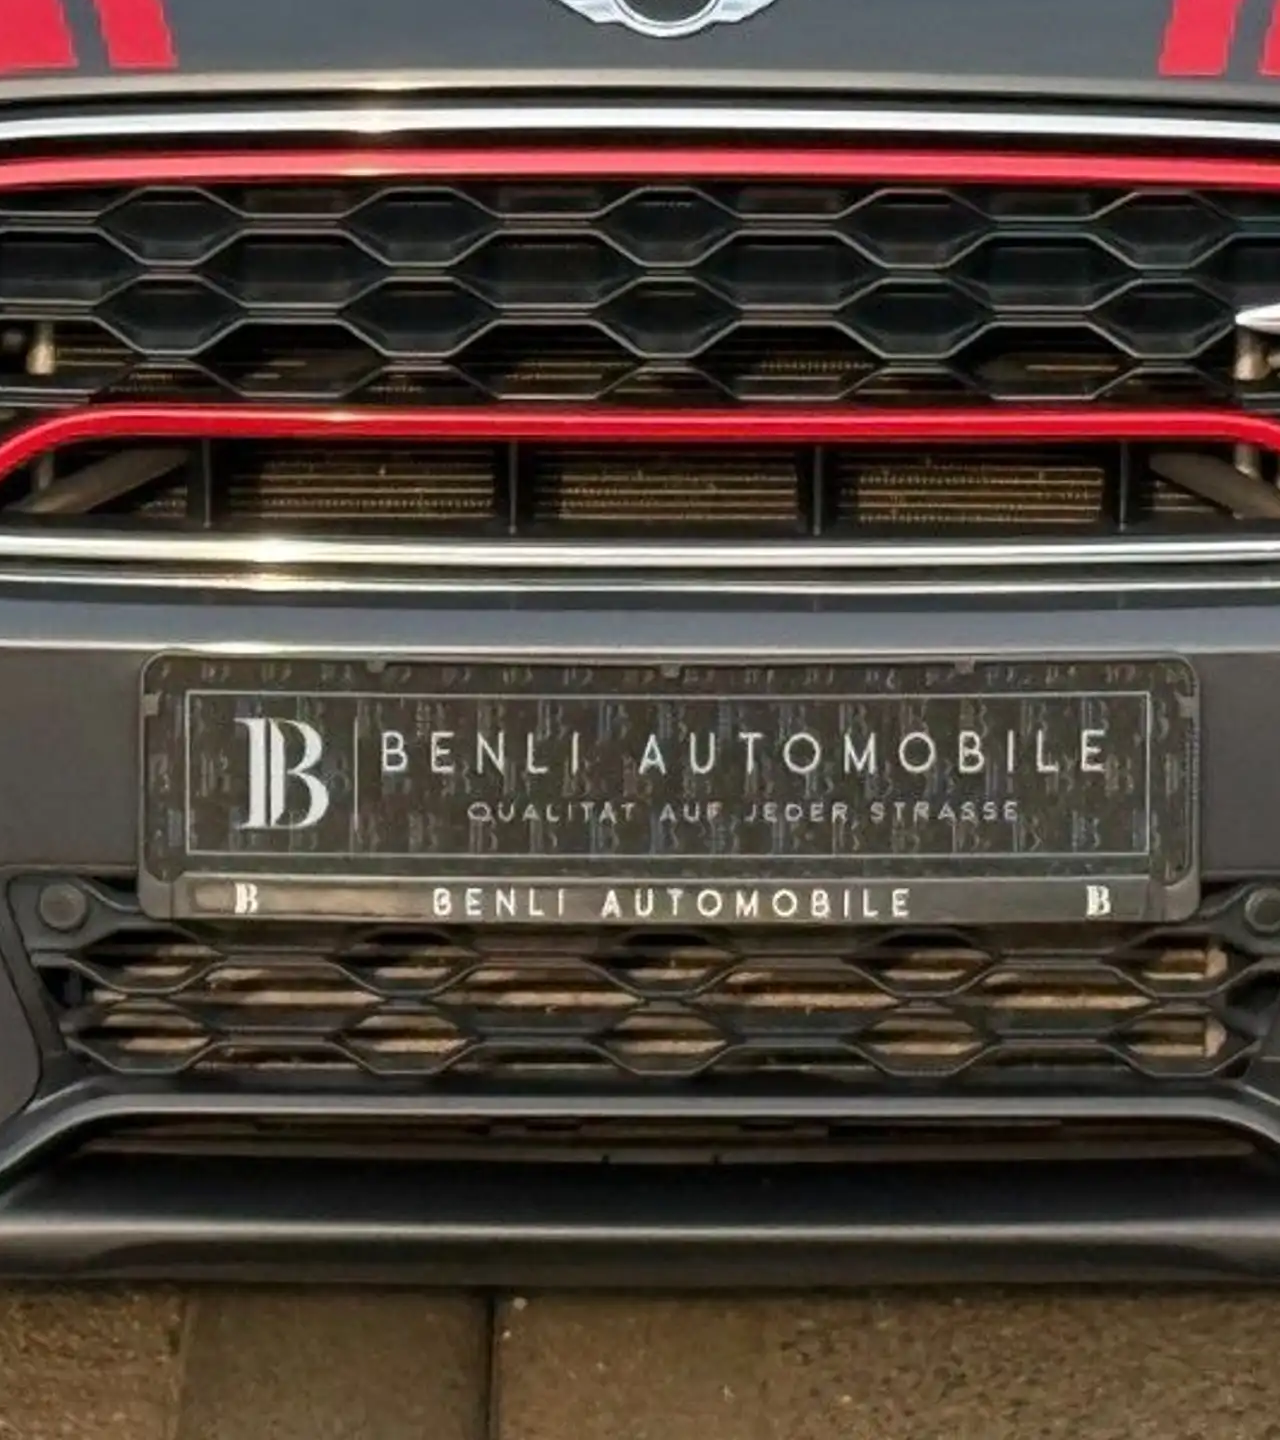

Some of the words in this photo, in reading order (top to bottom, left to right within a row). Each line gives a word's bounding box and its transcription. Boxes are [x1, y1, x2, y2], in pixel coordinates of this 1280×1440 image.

[381, 730, 581, 775] BENLI
[638, 729, 1108, 775] AUTOMOBILE
[659, 801, 721, 823] AUF
[744, 801, 849, 823] JEDER
[870, 801, 1019, 823] STRASSE
[432, 886, 566, 918] BENLI
[601, 886, 911, 919] AUTOMOBILE
